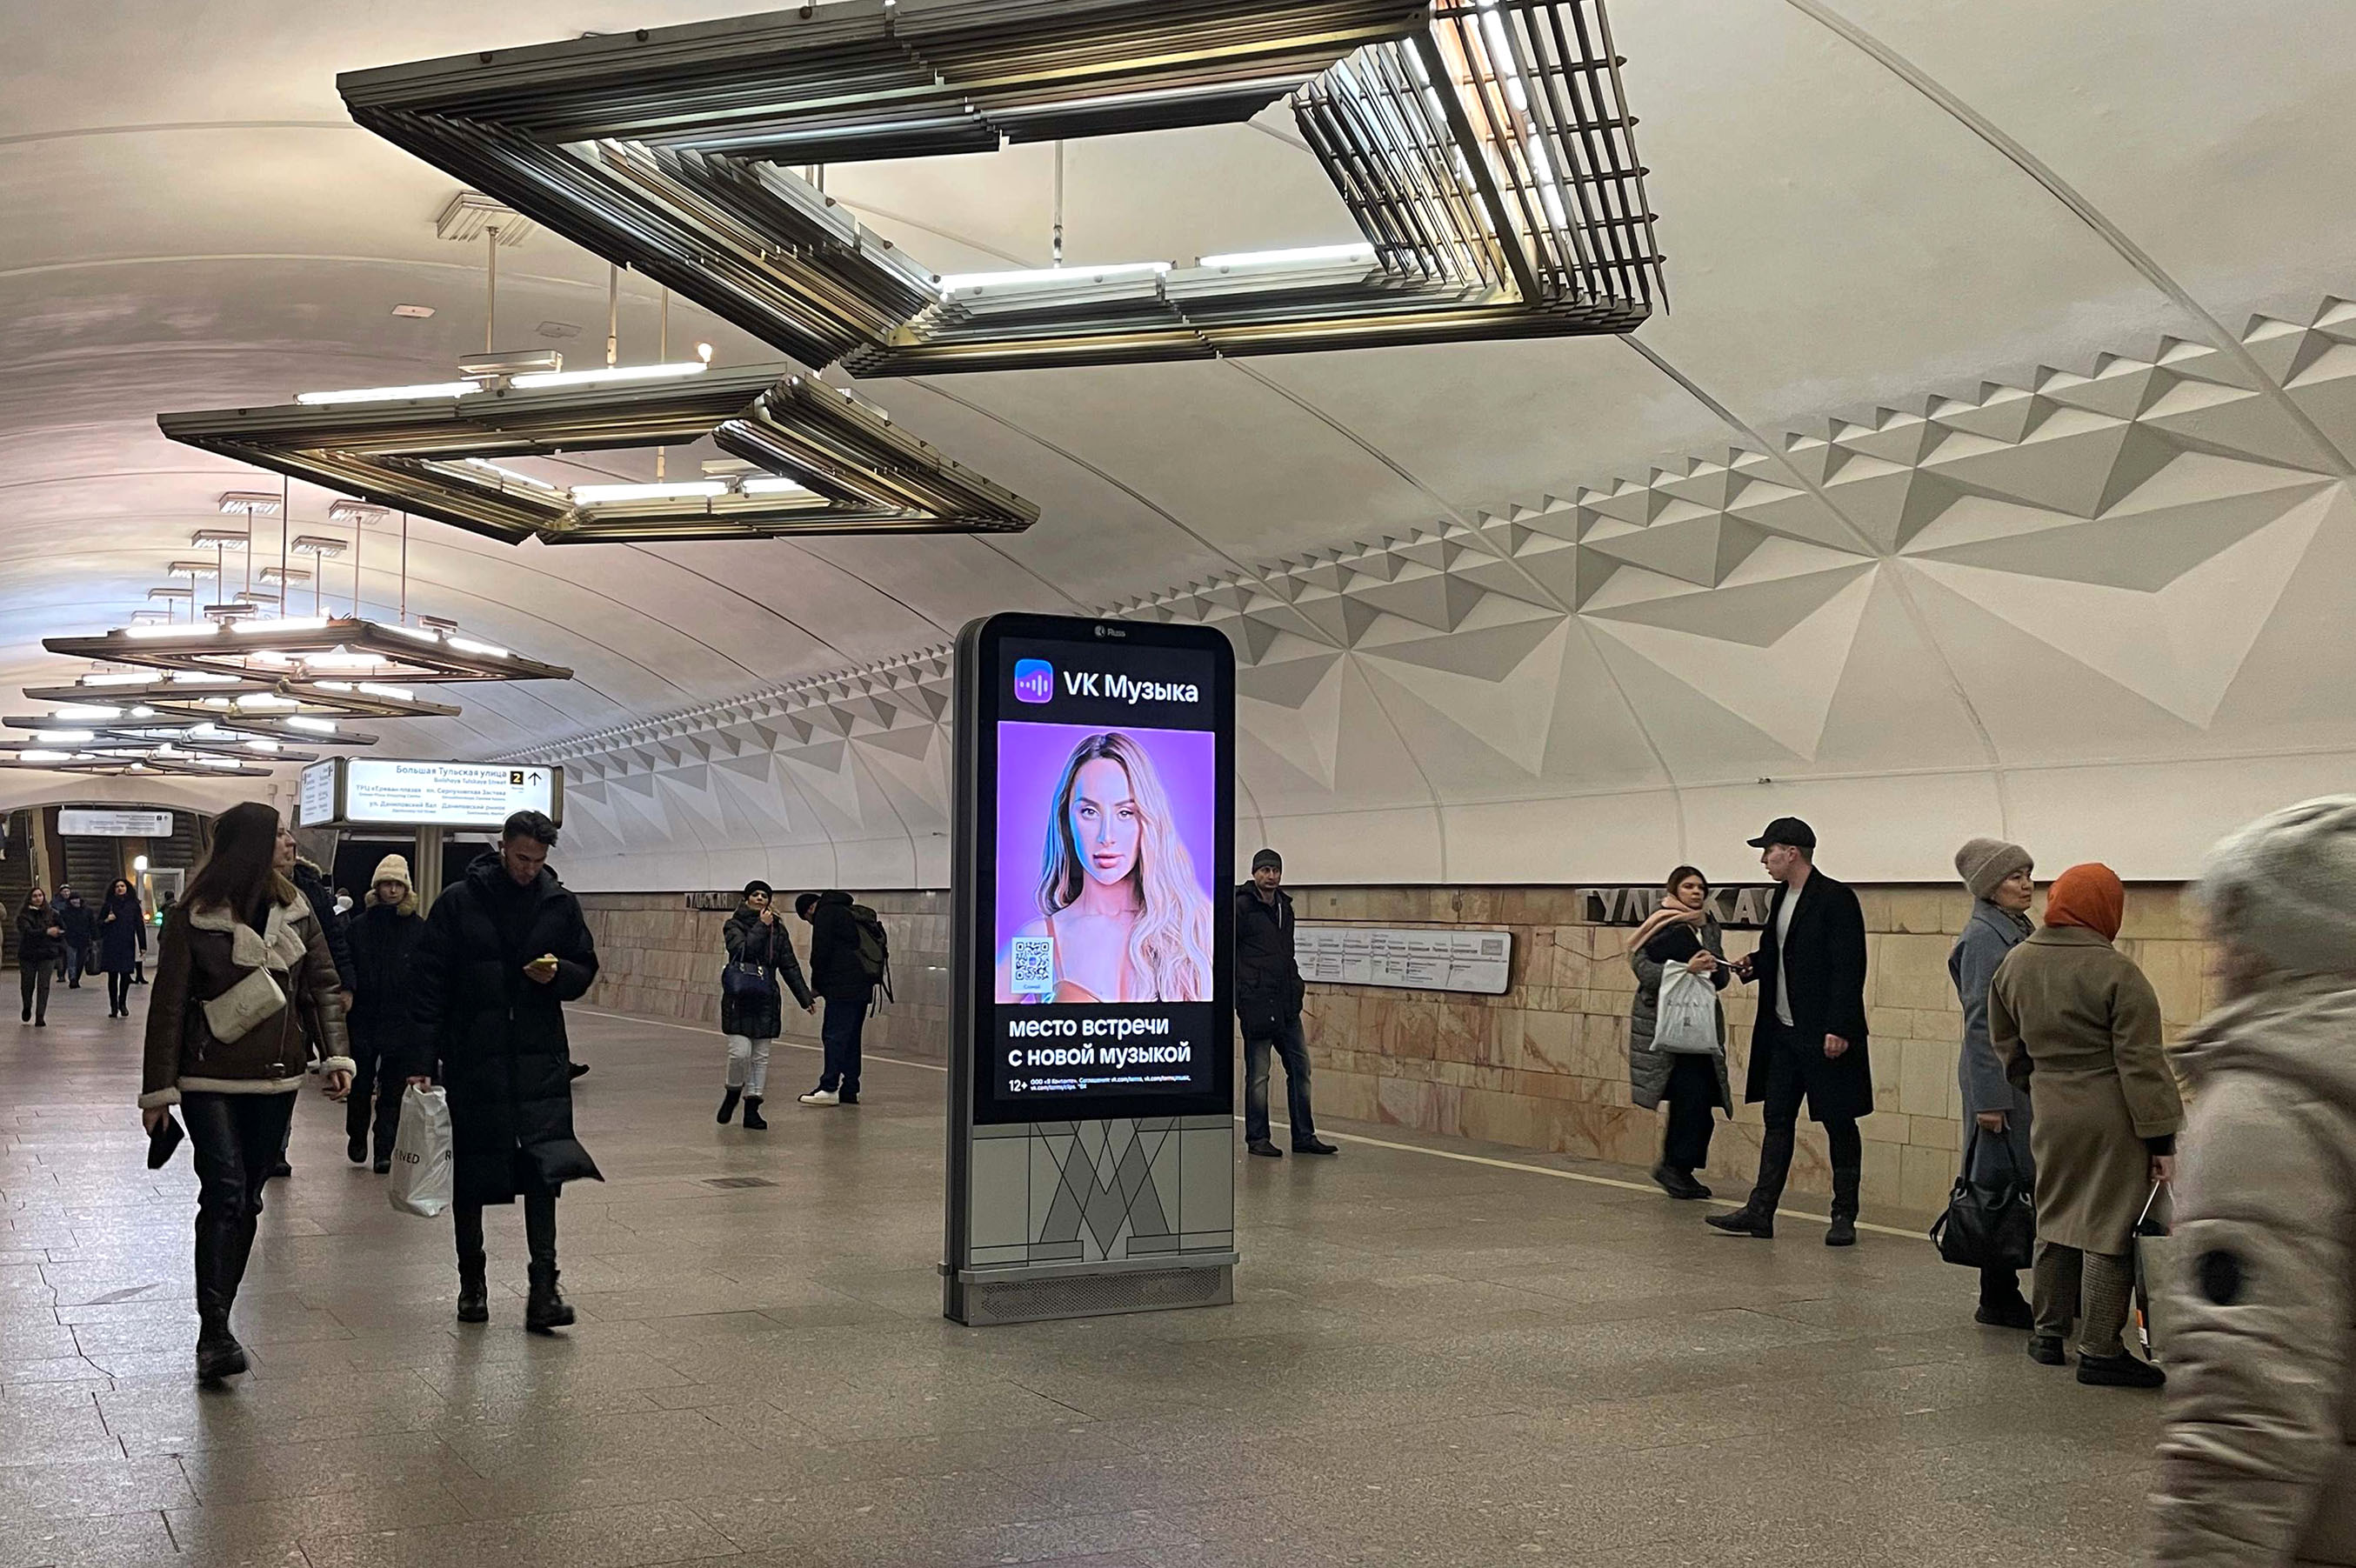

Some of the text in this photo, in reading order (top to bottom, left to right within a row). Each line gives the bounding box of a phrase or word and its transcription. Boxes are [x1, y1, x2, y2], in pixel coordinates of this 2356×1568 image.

[1063, 671, 1198, 704] VK Музыка
[396, 765, 521, 783] Большая Тульская улица 2
[1009, 1018, 1169, 1040] место встречи
[1008, 1041, 1191, 1069] с новой музыкой
[1009, 1078, 1028, 1091] 12+
